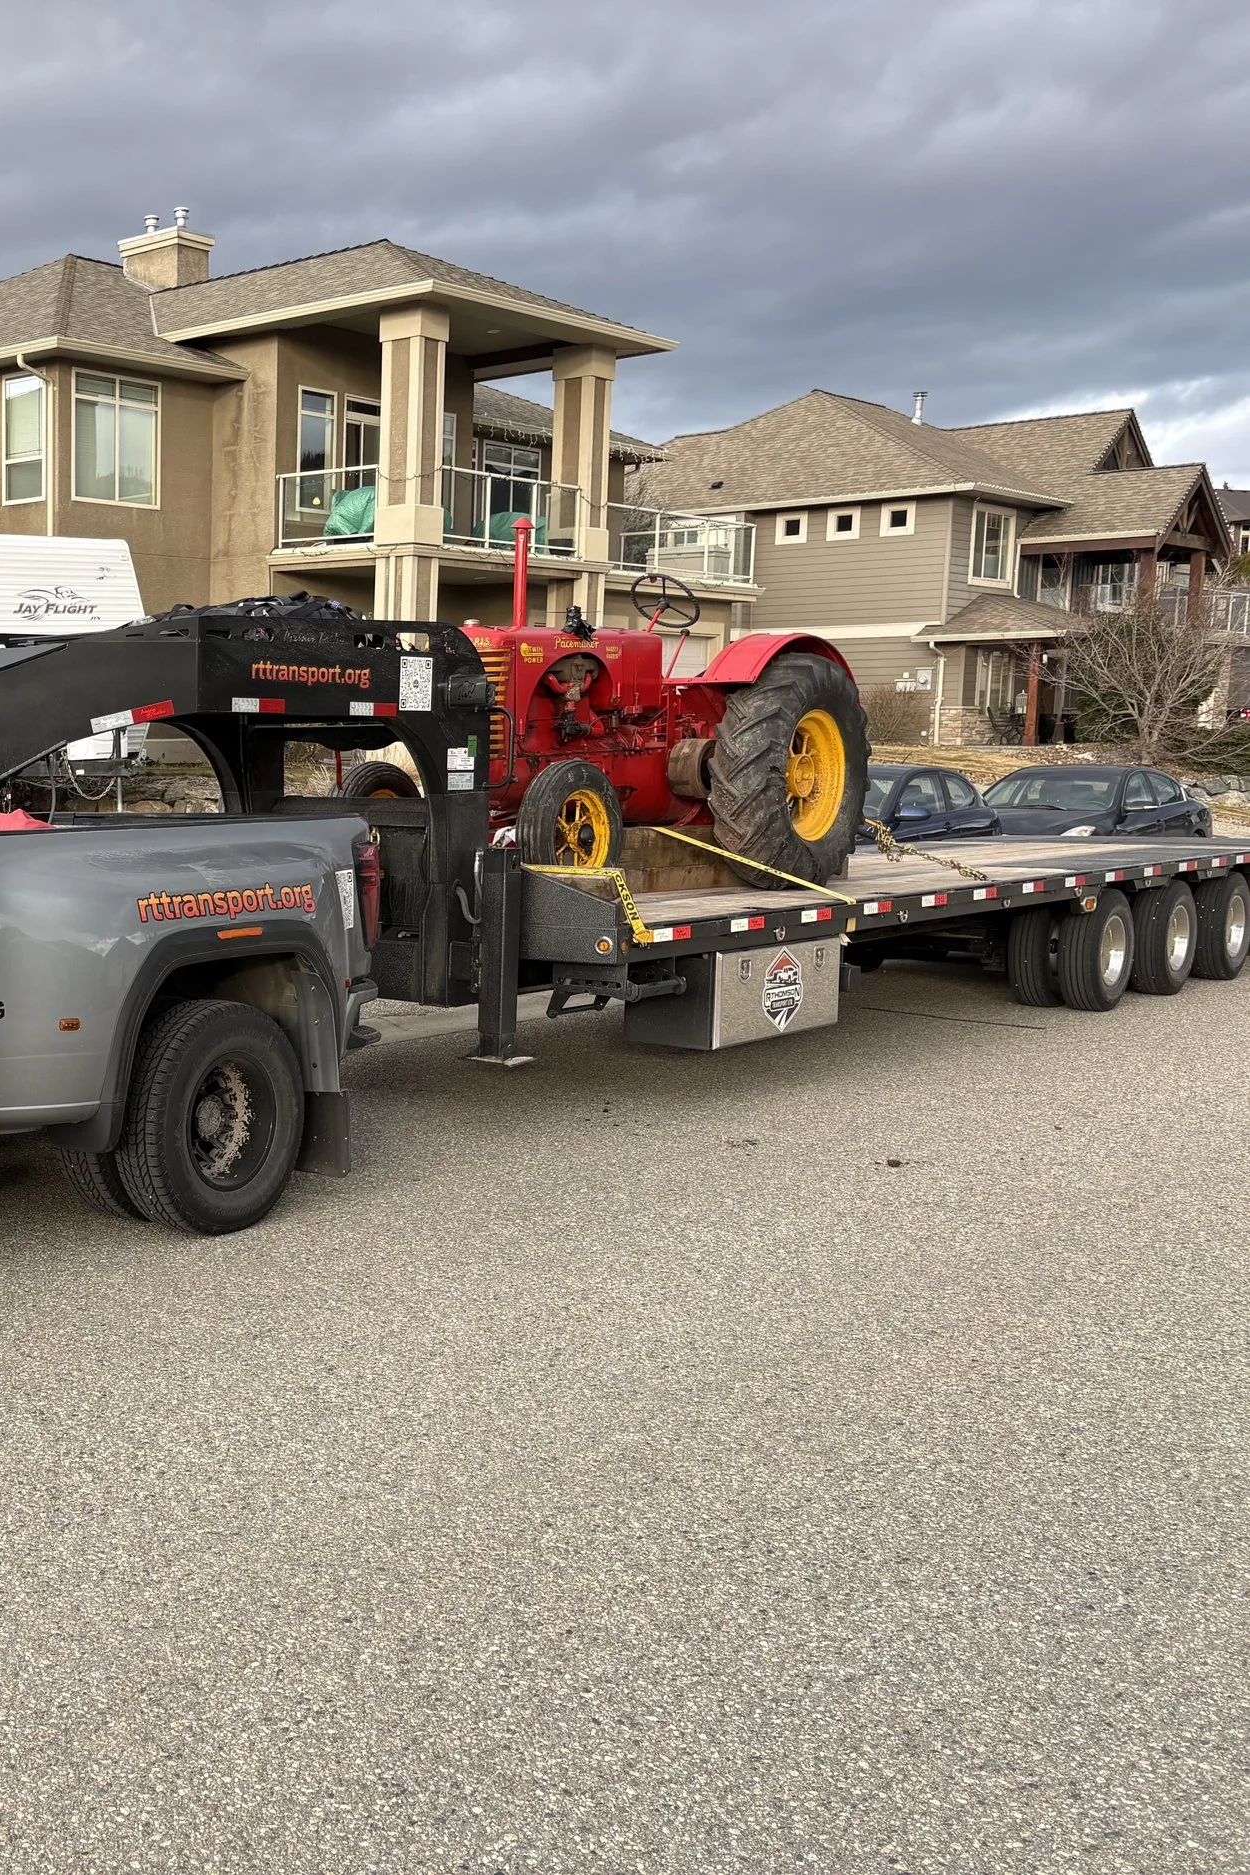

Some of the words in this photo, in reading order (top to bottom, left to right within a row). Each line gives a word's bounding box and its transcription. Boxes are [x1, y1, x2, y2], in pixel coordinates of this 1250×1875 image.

[12, 603, 41, 614] JAY
[44, 603, 98, 614] FLIGHT
[251, 660, 370, 689] rttransport.org
[137, 882, 317, 923] rttransport.org
